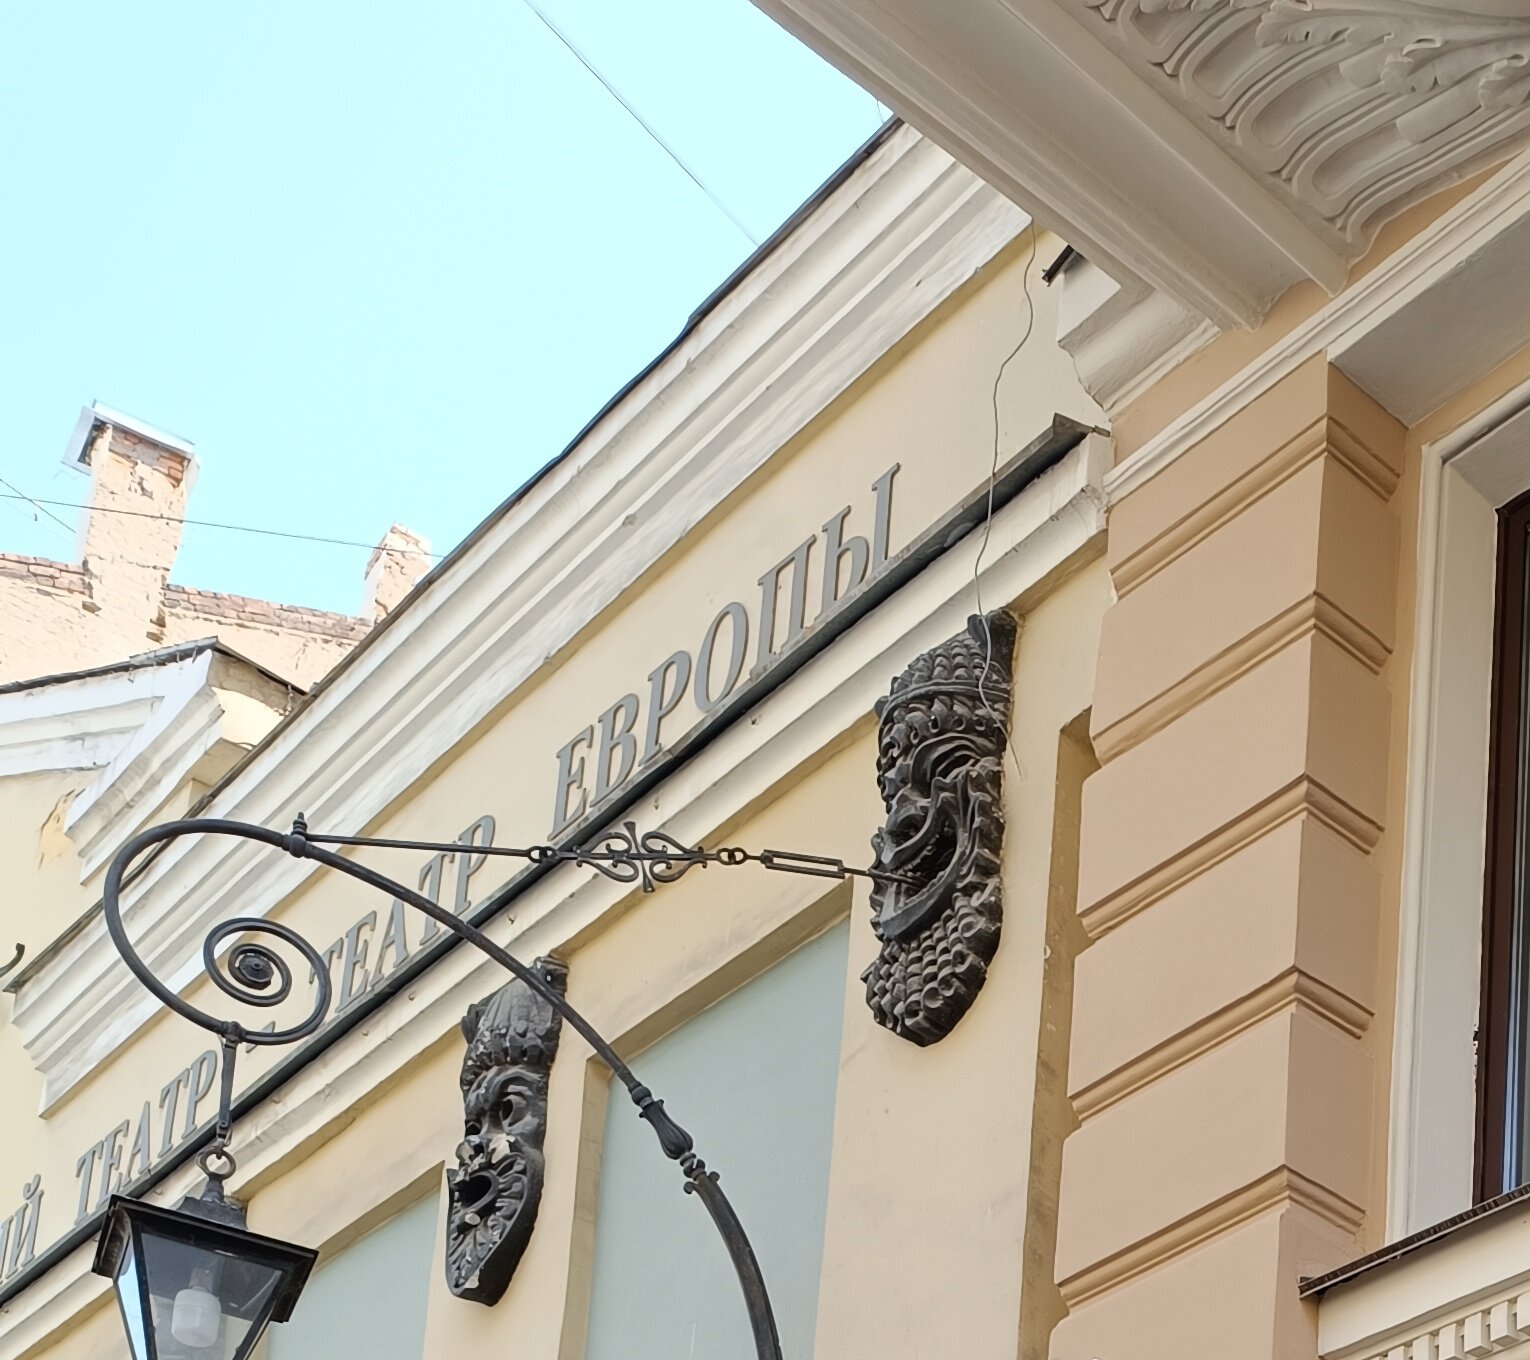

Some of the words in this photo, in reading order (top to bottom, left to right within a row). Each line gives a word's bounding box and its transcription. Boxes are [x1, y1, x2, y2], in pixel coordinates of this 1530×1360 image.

[75, 1049, 218, 1227] ТЕАТР
[309, 814, 496, 1030] ТЕАТР
[547, 462, 901, 841] ЕВРОПЫ
